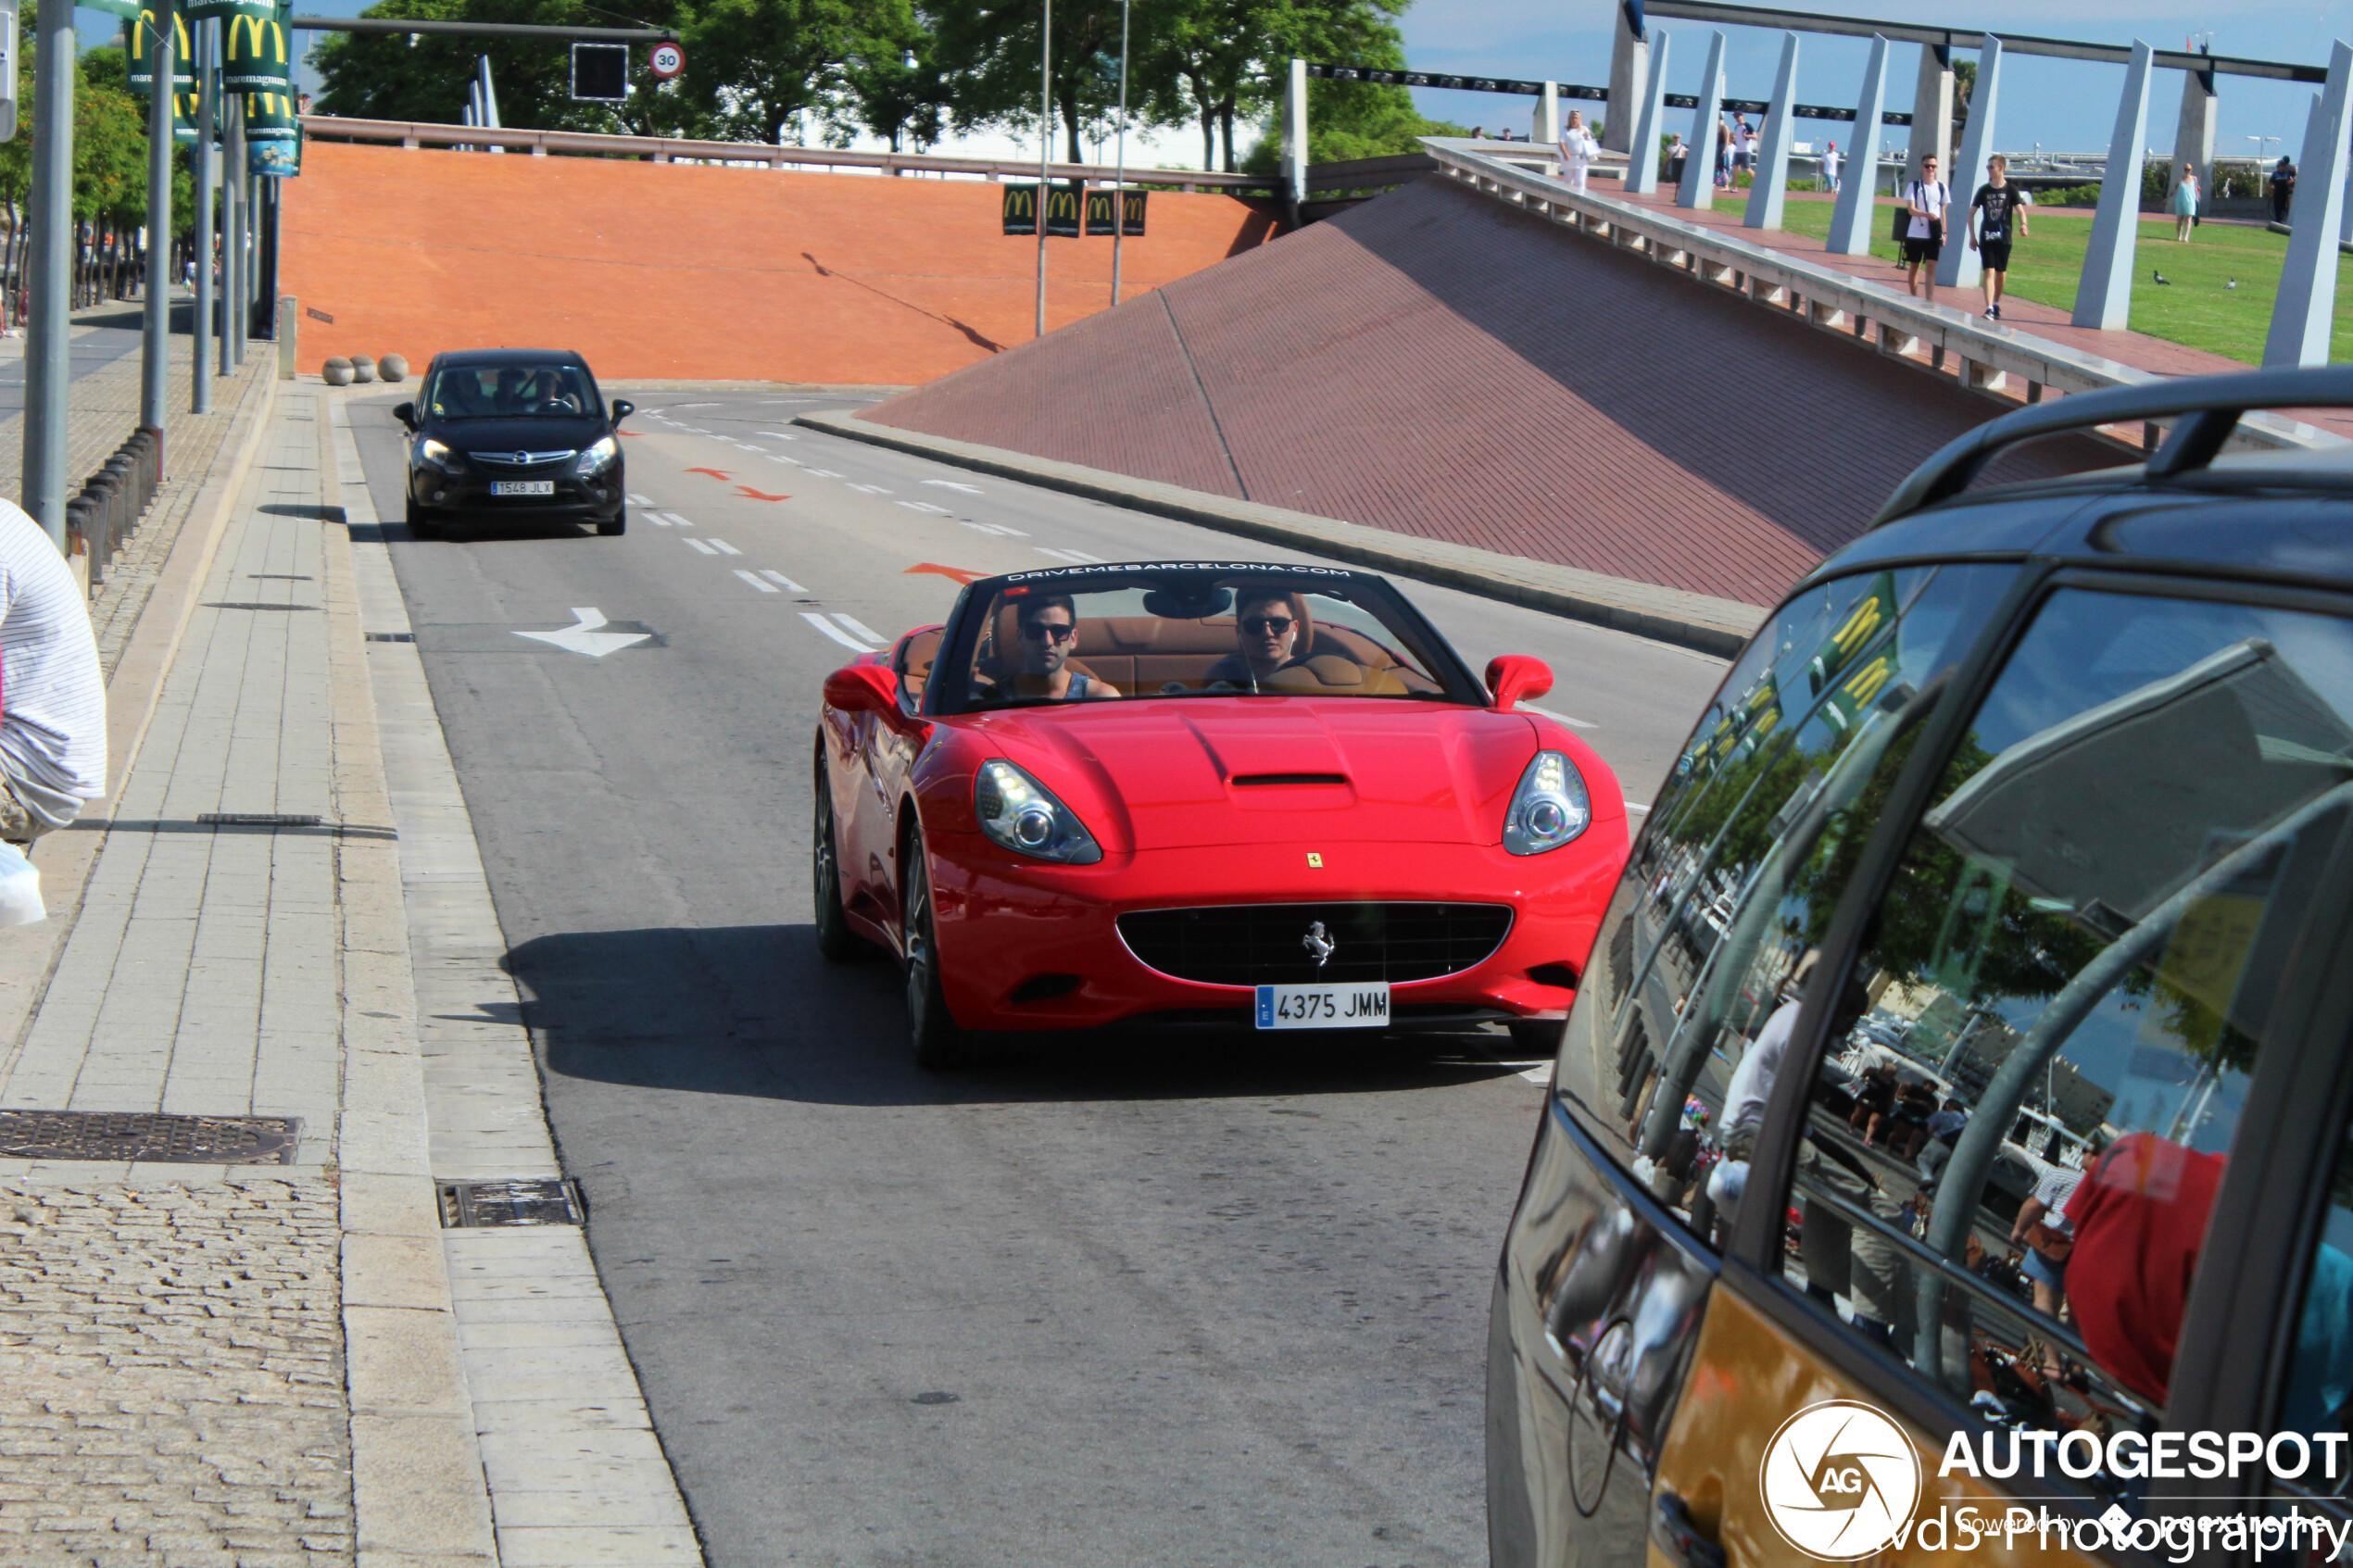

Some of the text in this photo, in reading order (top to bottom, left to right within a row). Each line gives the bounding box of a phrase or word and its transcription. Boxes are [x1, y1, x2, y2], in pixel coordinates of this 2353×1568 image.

[658, 54, 676, 67] 30
[131, 74, 194, 83] marenum
[226, 74, 287, 86] maremagnum
[499, 483, 551, 494] 1548 JLX
[1007, 562, 1352, 582] DRIVEMEBARCELONA.COM
[1277, 992, 1387, 1020] 4375 JMM
